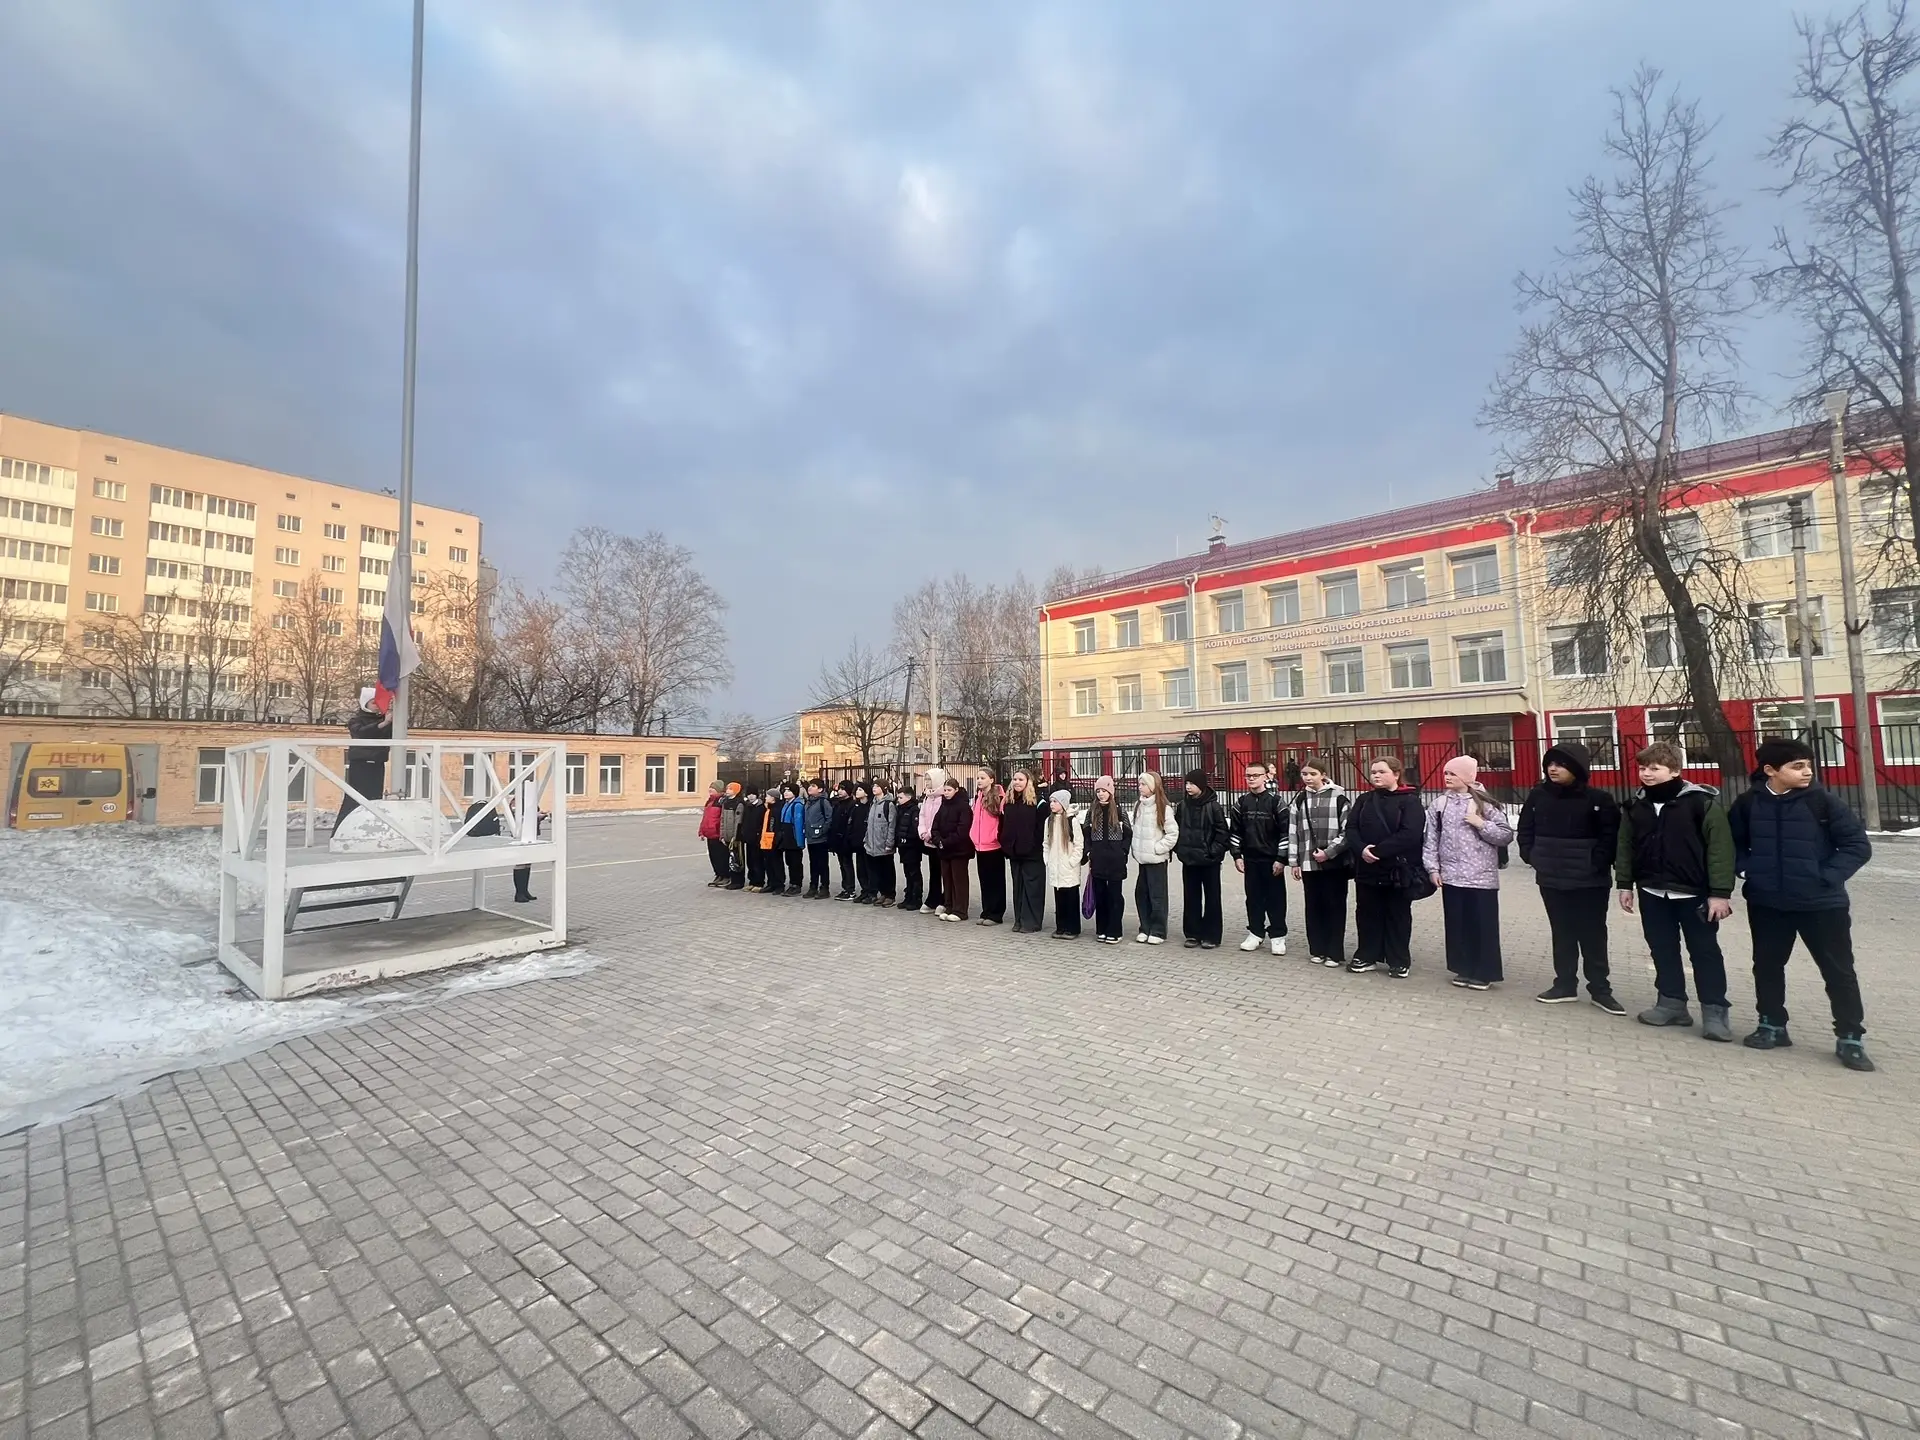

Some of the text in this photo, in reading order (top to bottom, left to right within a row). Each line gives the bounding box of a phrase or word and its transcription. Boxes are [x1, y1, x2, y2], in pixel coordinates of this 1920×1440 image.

[1267, 628, 1312, 640] средняя
[1315, 608, 1457, 633] общеобразовательная
[1461, 600, 1509, 614] школа
[1273, 640, 1308, 652] имени
[1359, 628, 1413, 642] Павлова
[48, 752, 105, 765] ДЕТИ
[103, 804, 115, 812] 60
